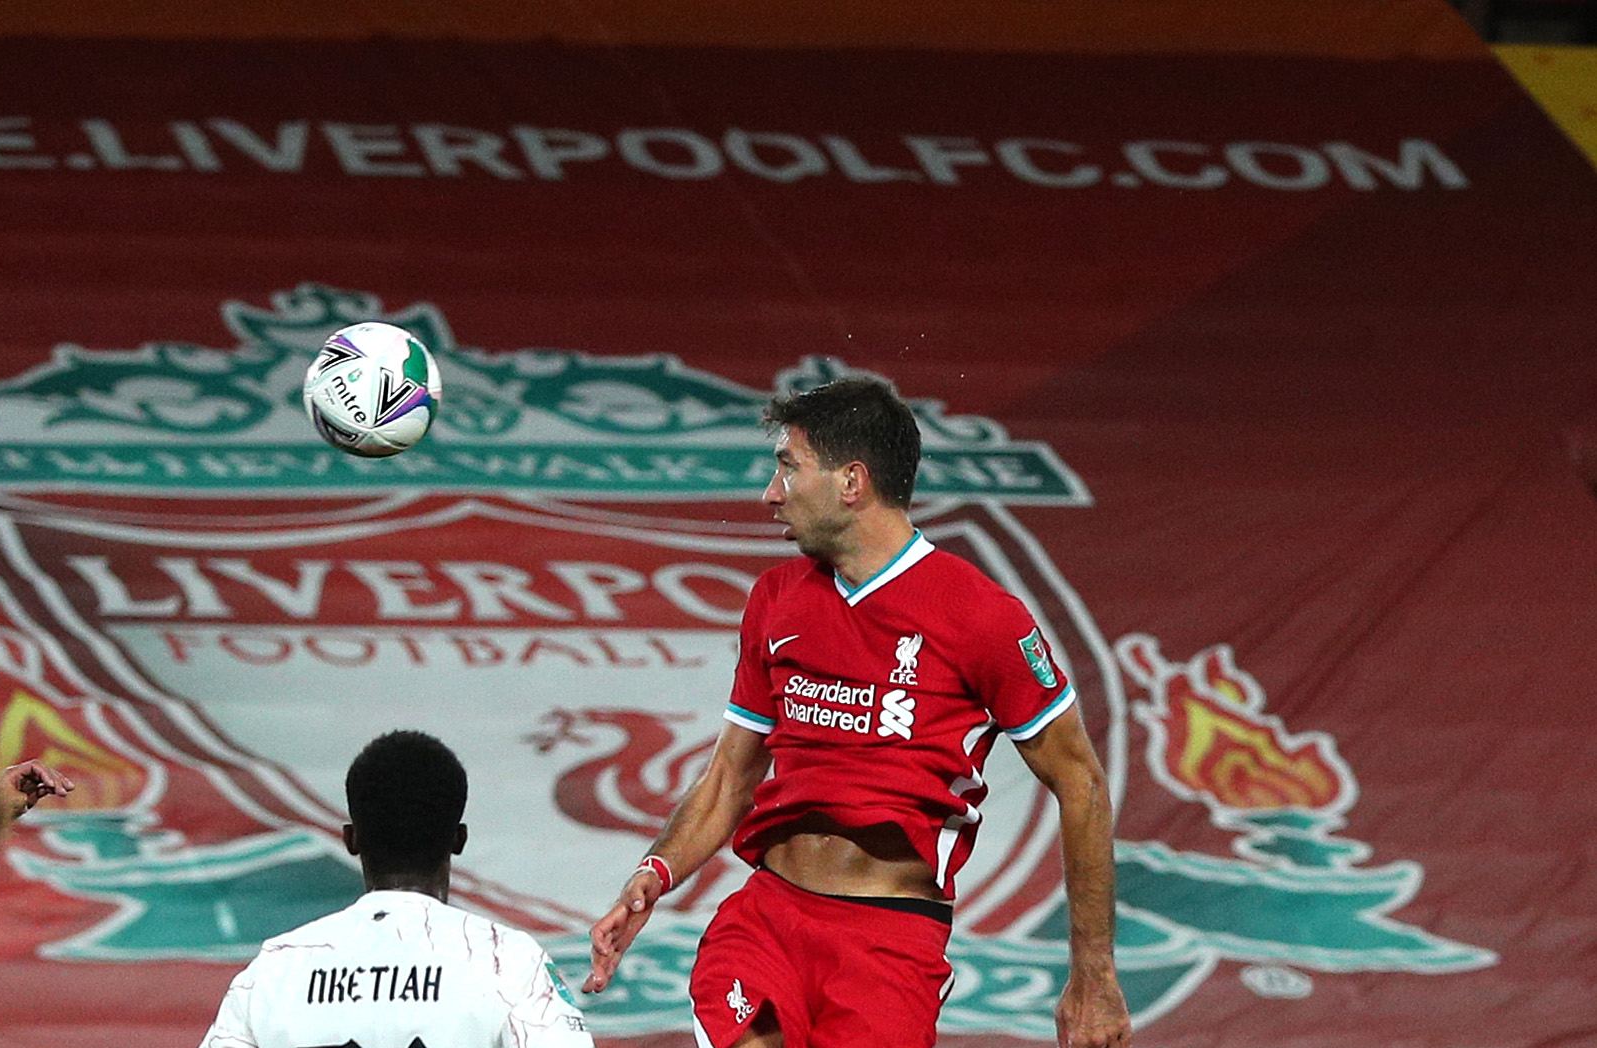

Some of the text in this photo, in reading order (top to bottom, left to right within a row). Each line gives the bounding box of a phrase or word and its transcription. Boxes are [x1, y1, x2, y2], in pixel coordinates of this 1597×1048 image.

[331, 376, 367, 423] mitre
[784, 675, 875, 707] Standard
[784, 696, 872, 734] Chartered
